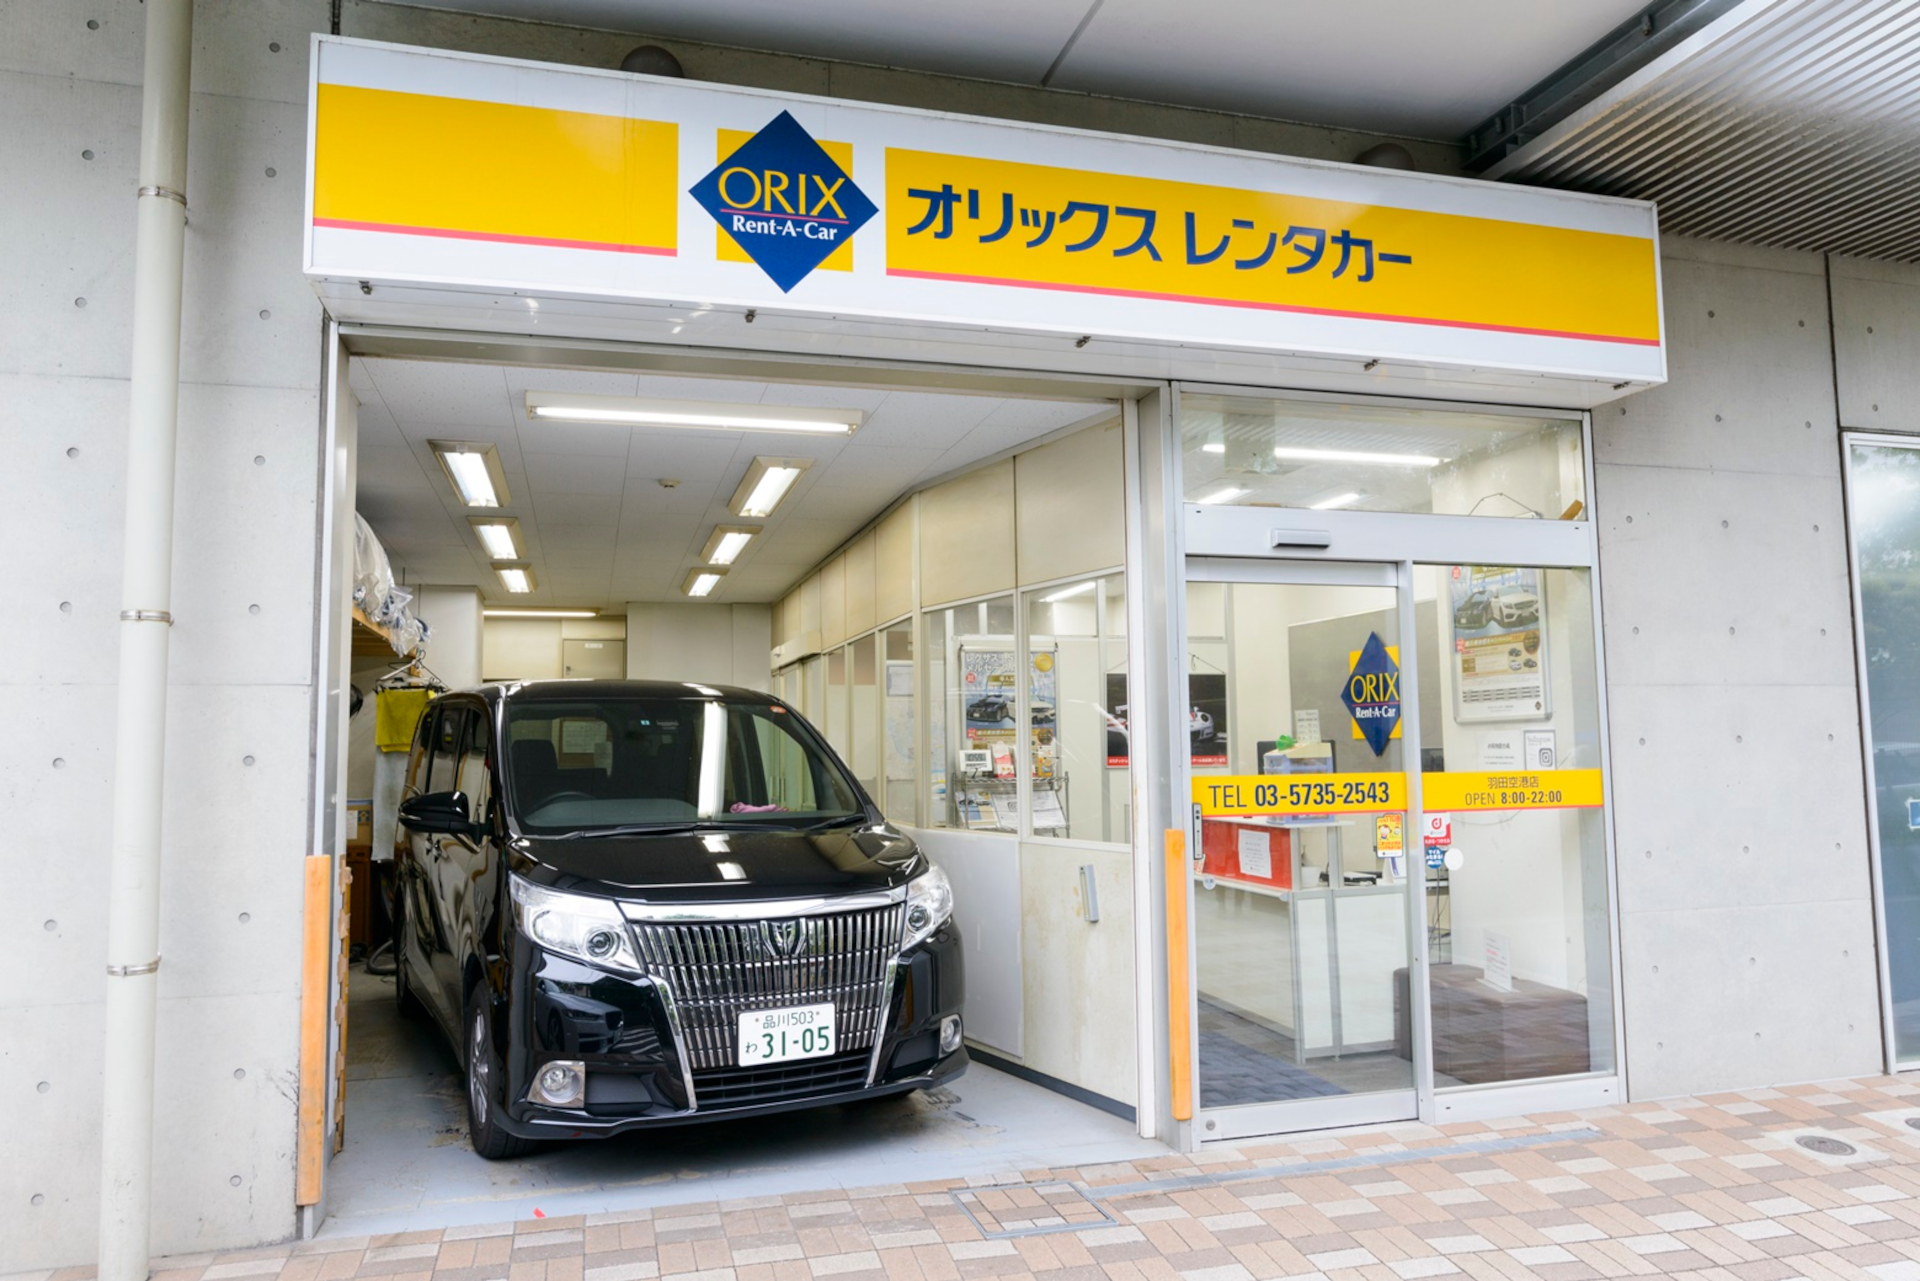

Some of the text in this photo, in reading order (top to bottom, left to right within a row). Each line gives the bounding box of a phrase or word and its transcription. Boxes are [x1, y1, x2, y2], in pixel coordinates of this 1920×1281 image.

[718, 166, 847, 219] ORIX
[732, 214, 838, 241] Rent-A-Car
[907, 184, 1412, 282] オリックス レンタカー
[1350, 671, 1400, 703] ORIX
[1355, 705, 1397, 718] Rent-A-Car
[1208, 782, 1390, 808] TEL 03-5735-2543
[1487, 775, 1539, 790] 羽田空港店
[1465, 790, 1562, 806] OPEN 8:00-22:00
[745, 1025, 830, 1059] わ 31-05
